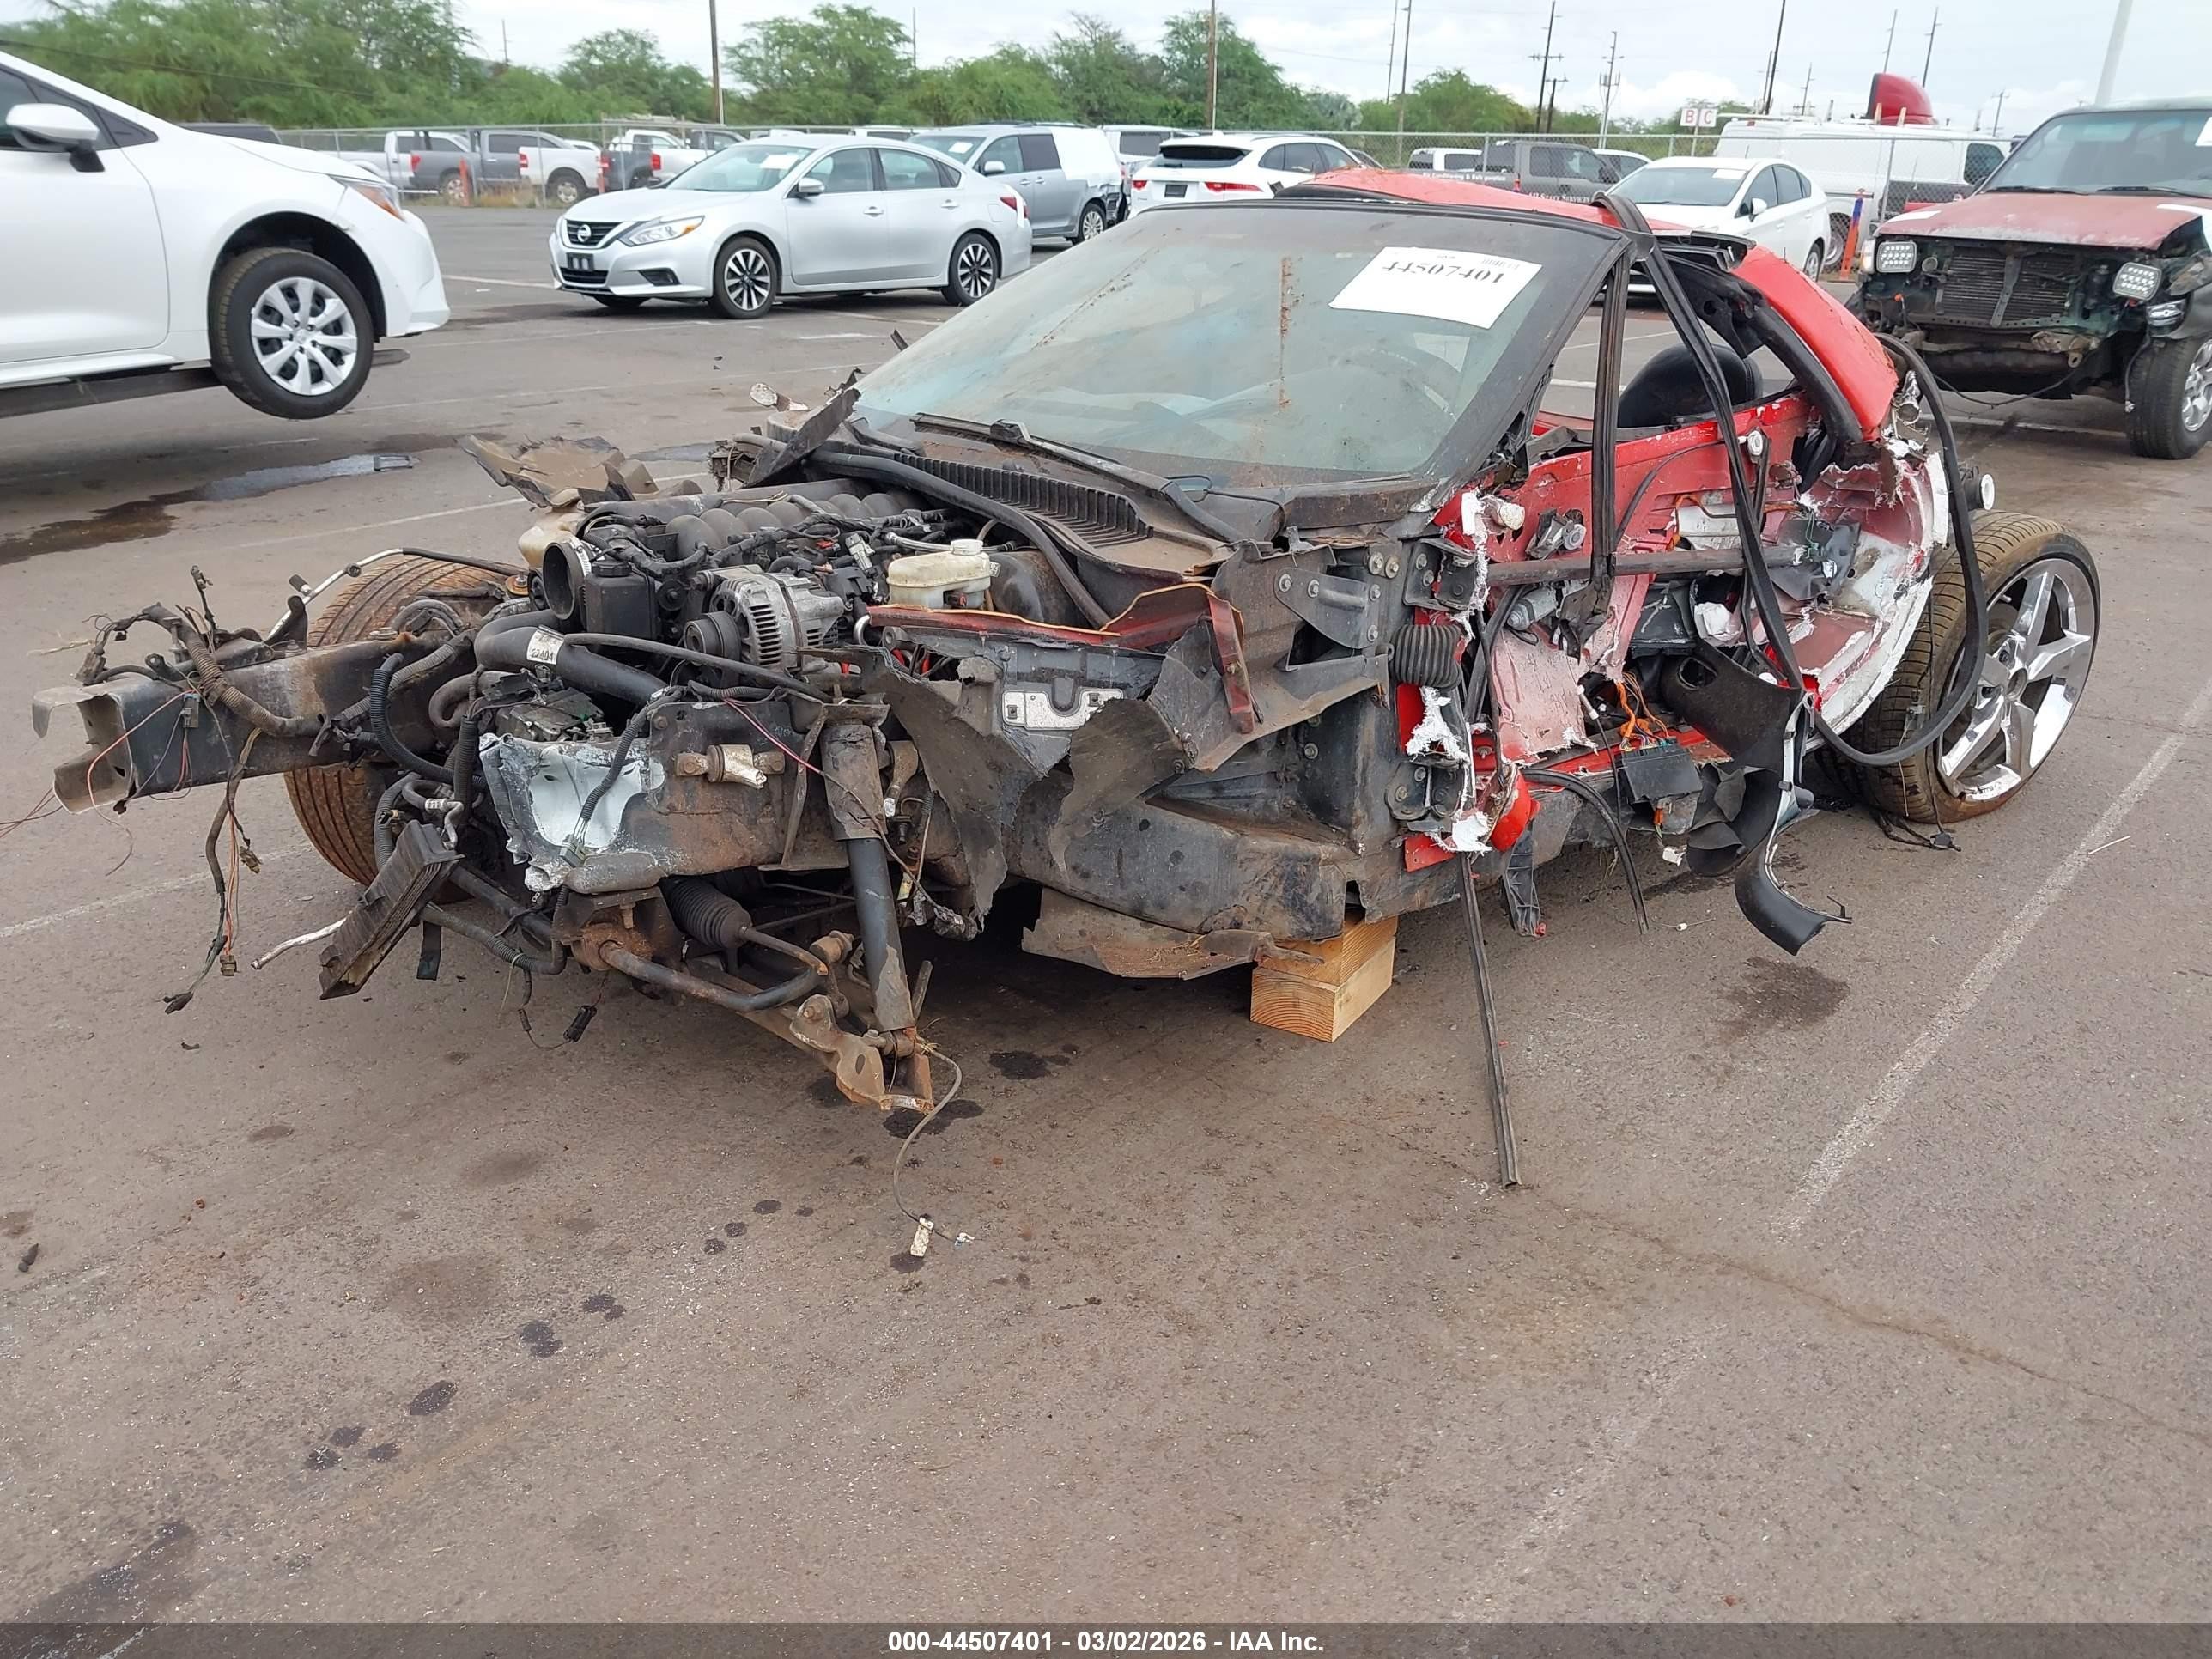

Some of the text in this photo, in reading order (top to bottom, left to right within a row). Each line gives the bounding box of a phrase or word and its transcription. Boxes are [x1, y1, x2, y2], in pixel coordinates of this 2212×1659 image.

[1685, 109, 1695, 124] B
[1704, 110, 1713, 125] C
[1382, 261, 1505, 283] 44507401
